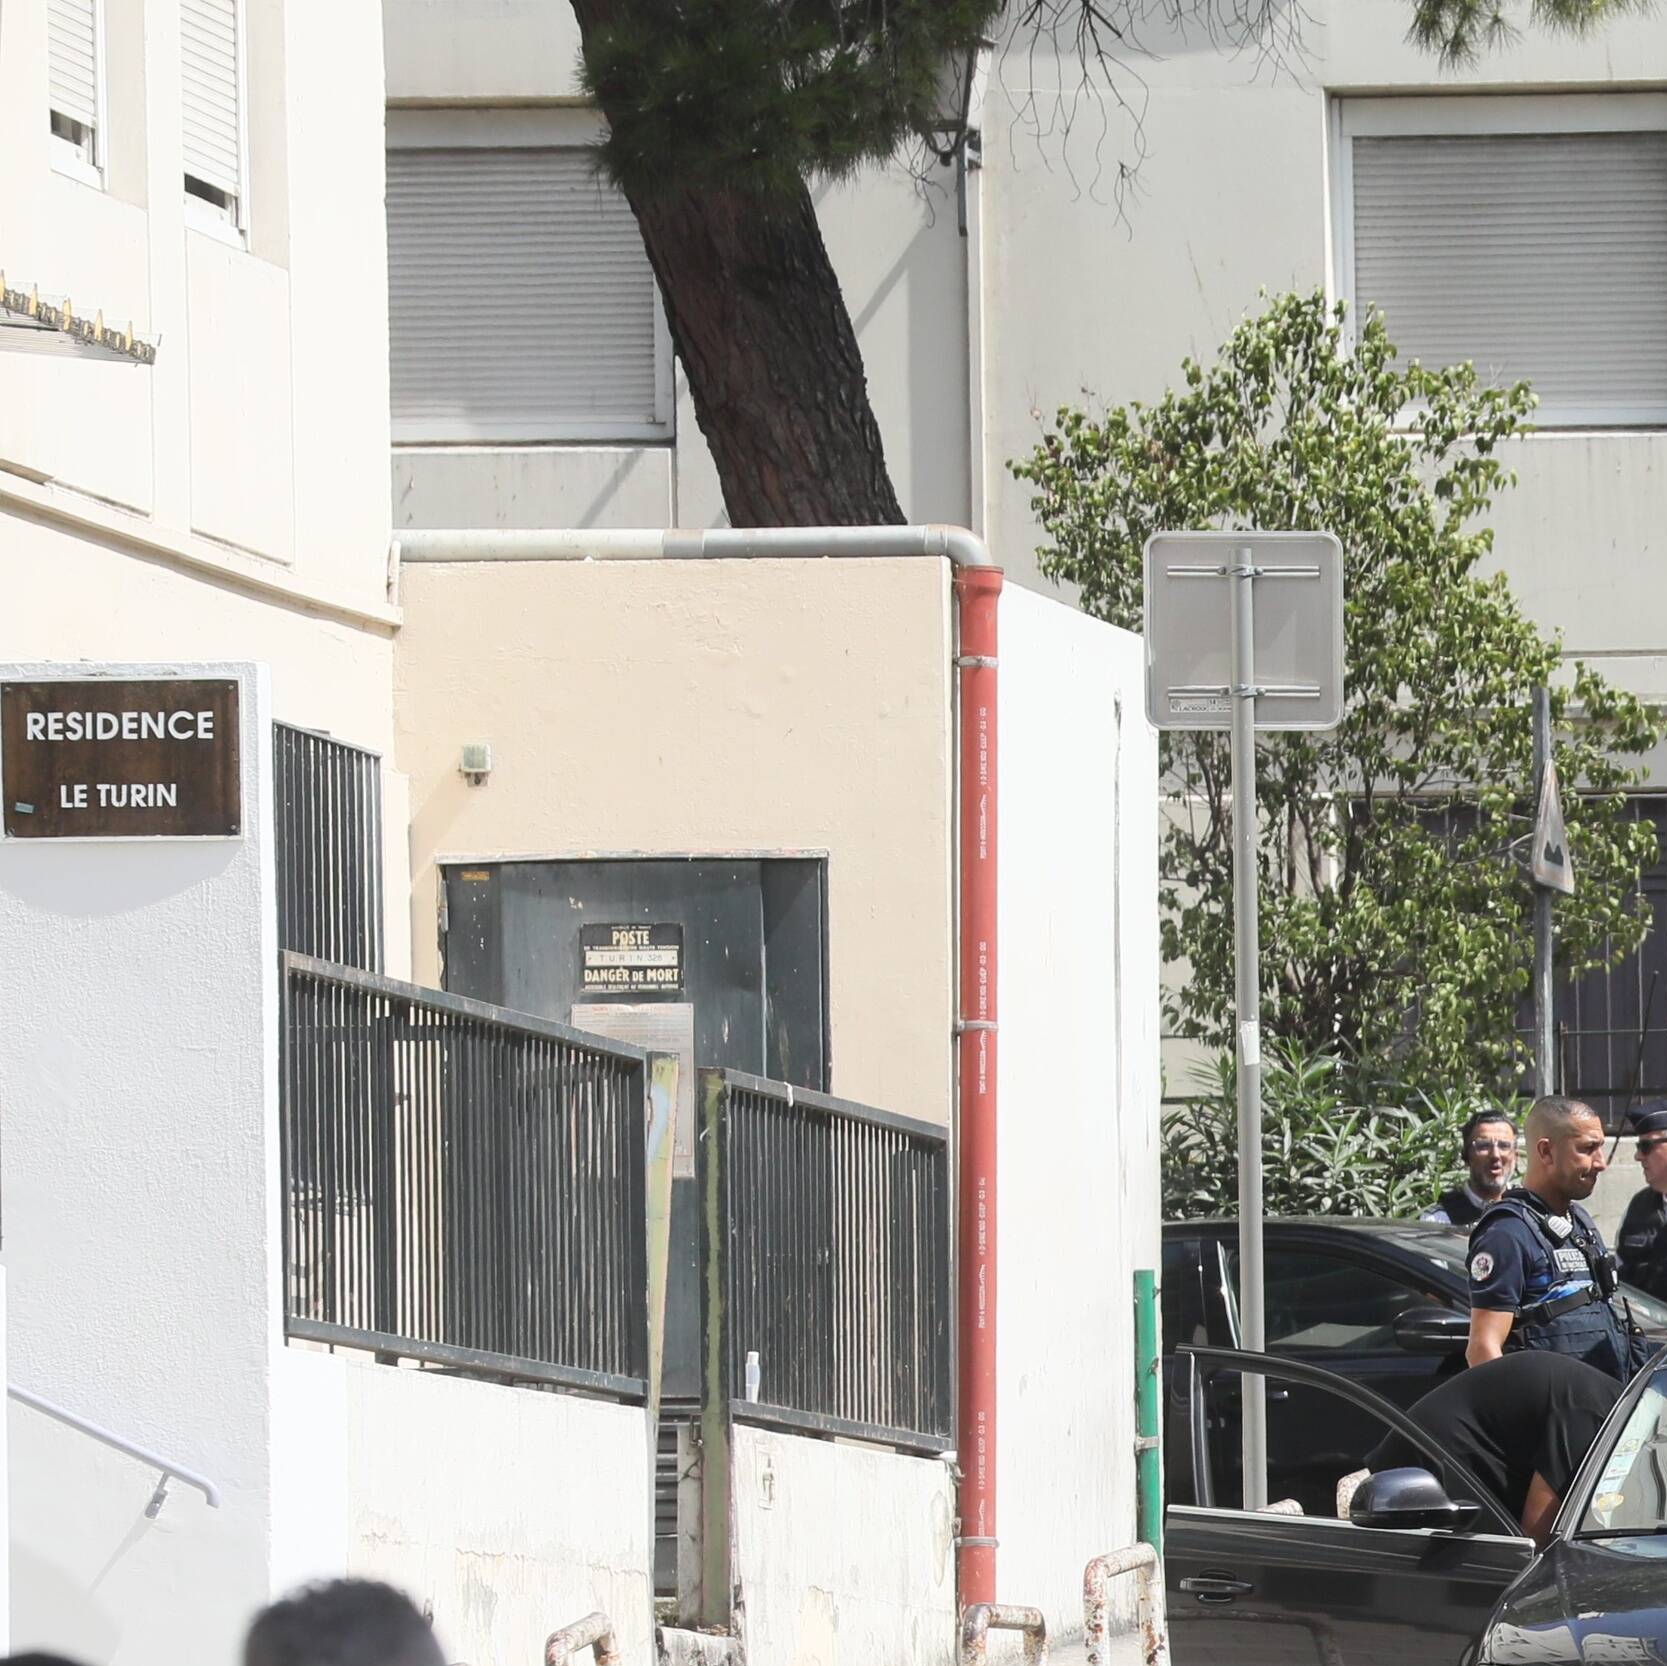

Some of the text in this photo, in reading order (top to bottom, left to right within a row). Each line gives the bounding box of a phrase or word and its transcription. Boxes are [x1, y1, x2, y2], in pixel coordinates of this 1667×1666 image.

[26, 710, 214, 741] RESIDENCE
[60, 783, 177, 808] LE TURIN
[612, 930, 650, 945] POSTE
[584, 968, 629, 982] DANGER
[632, 971, 644, 982] DE
[646, 969, 678, 982] MORT
